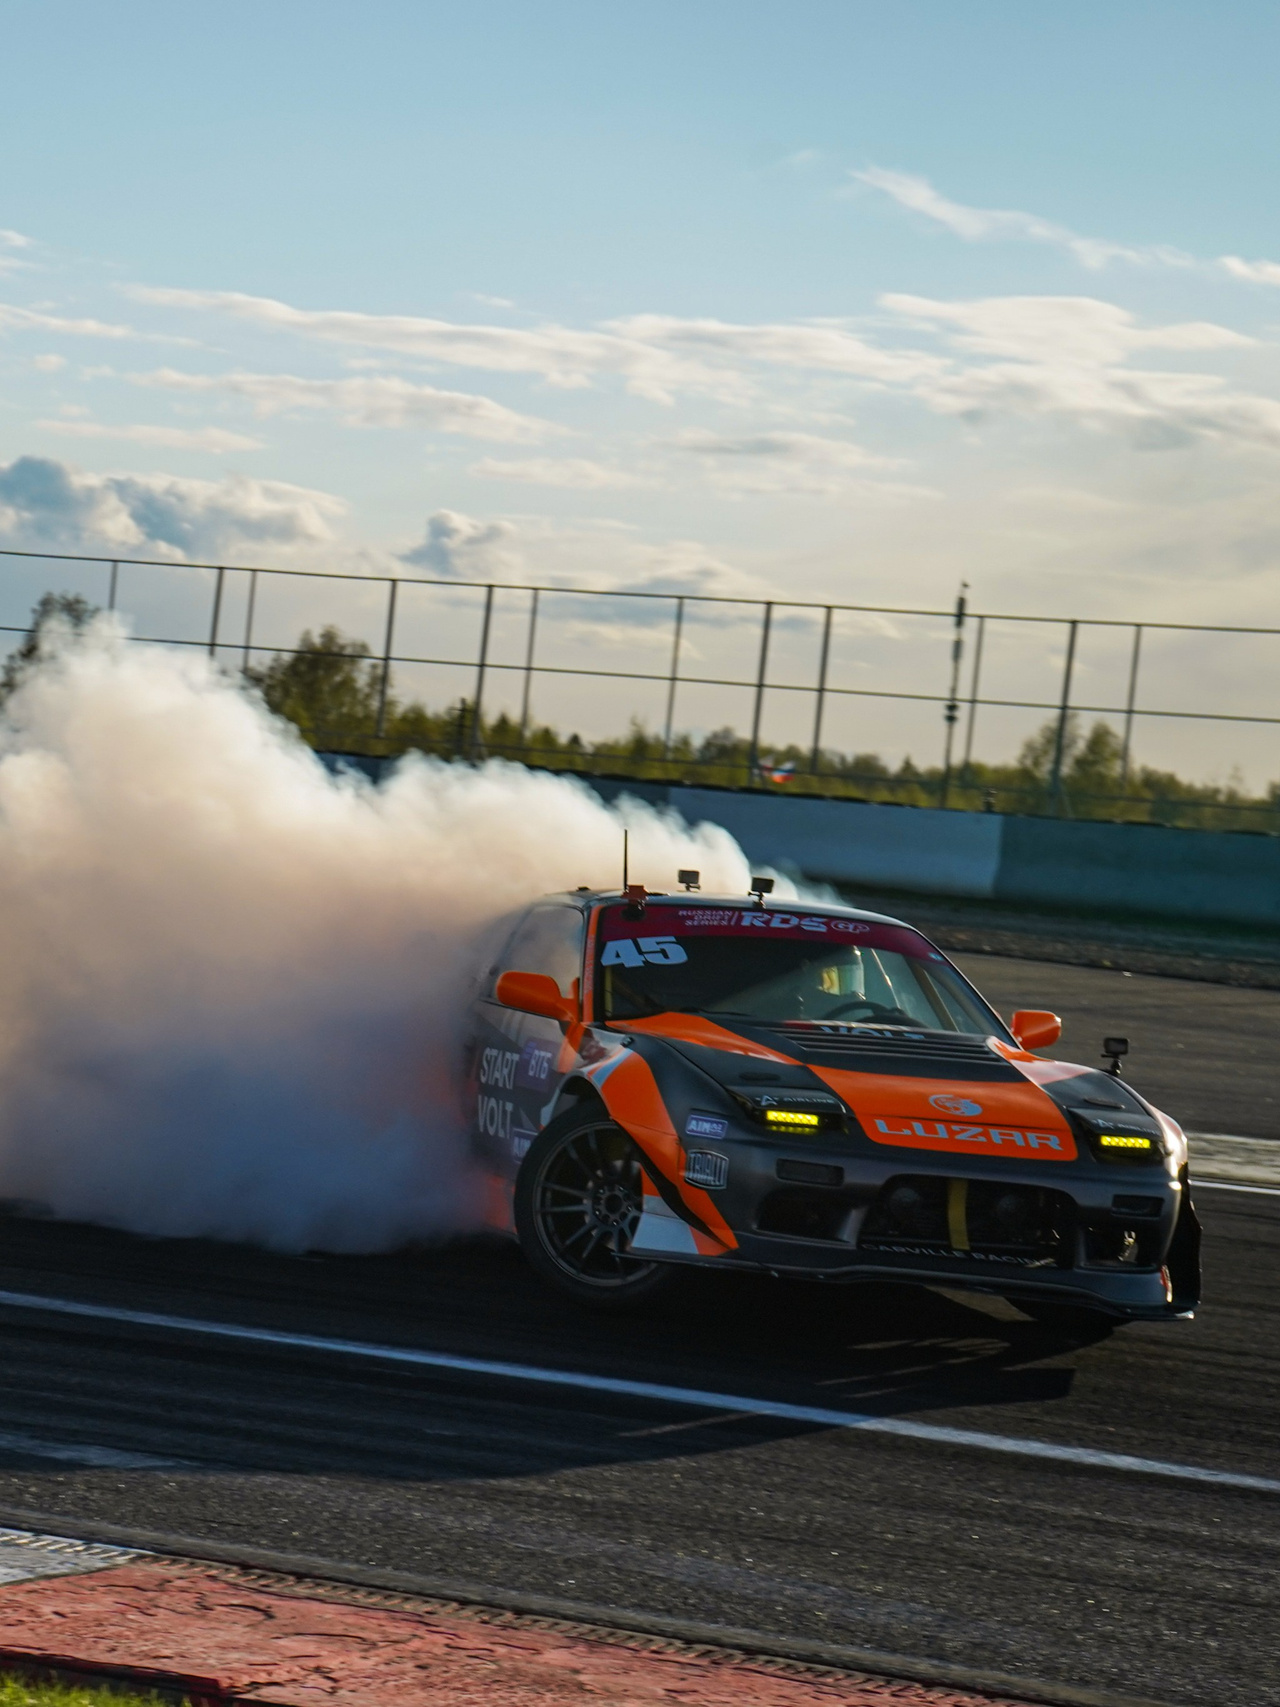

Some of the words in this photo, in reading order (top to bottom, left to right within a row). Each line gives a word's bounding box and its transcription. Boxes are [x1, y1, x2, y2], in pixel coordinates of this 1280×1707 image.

[678, 910, 732, 918] RUSSIAN
[685, 919, 729, 927] SERIES
[740, 911, 830, 932] RDS
[600, 936, 689, 969] 45
[480, 1047, 520, 1090] START
[478, 1094, 514, 1139] VOLT
[874, 1119, 1064, 1151] LUZAR
[861, 1244, 967, 1258] CARVILLE
